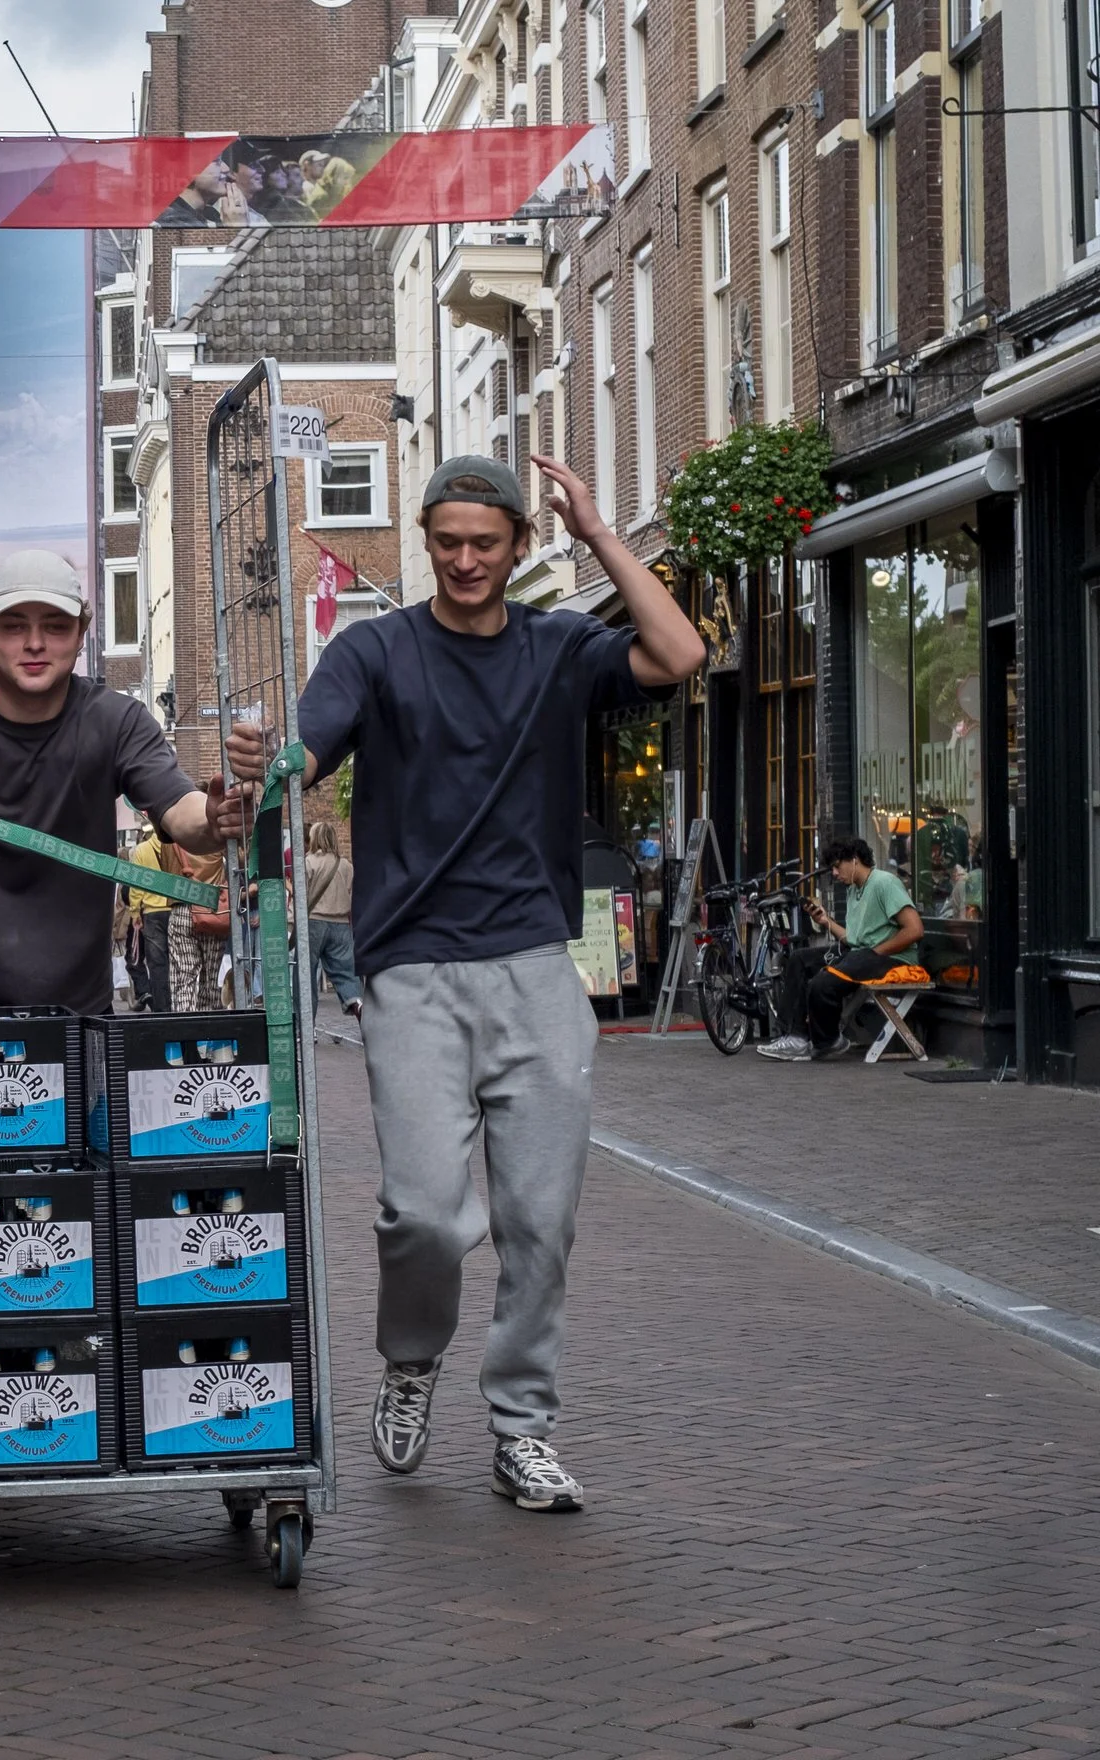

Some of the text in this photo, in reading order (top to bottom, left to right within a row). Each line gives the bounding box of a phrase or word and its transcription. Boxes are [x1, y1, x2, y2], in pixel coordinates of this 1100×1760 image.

[173, 1065, 261, 1106] BROUWERS
[20, 1118, 39, 1137] BIER
[186, 1122, 251, 1146] PREMIUM BIER
[180, 1214, 269, 1255] BROUWERS
[0, 1279, 66, 1303] PREMIUM BIER
[193, 1270, 259, 1294] PREMIUM BIER
[188, 1364, 276, 1405] BROUWERS
[3, 1432, 69, 1456] PREMIUM BIER
[200, 1420, 266, 1445] PREMIUM BIER
